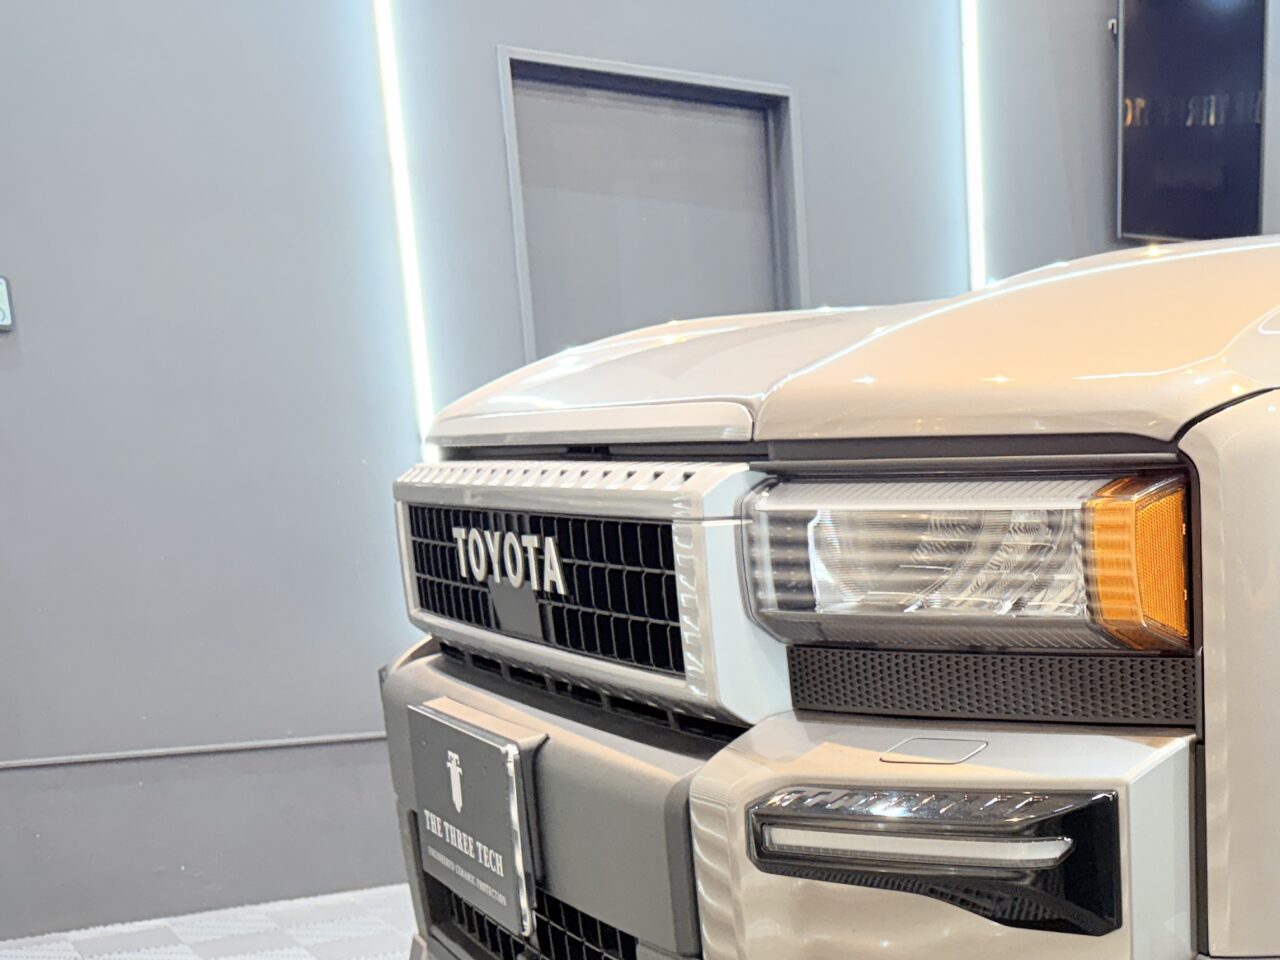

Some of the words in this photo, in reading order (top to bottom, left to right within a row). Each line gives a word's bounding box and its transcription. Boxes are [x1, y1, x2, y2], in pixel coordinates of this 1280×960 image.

[452, 527, 567, 595] TOYOTA
[423, 808, 444, 839] THE
[443, 820, 476, 859] THREE
[475, 840, 505, 878] TECH
